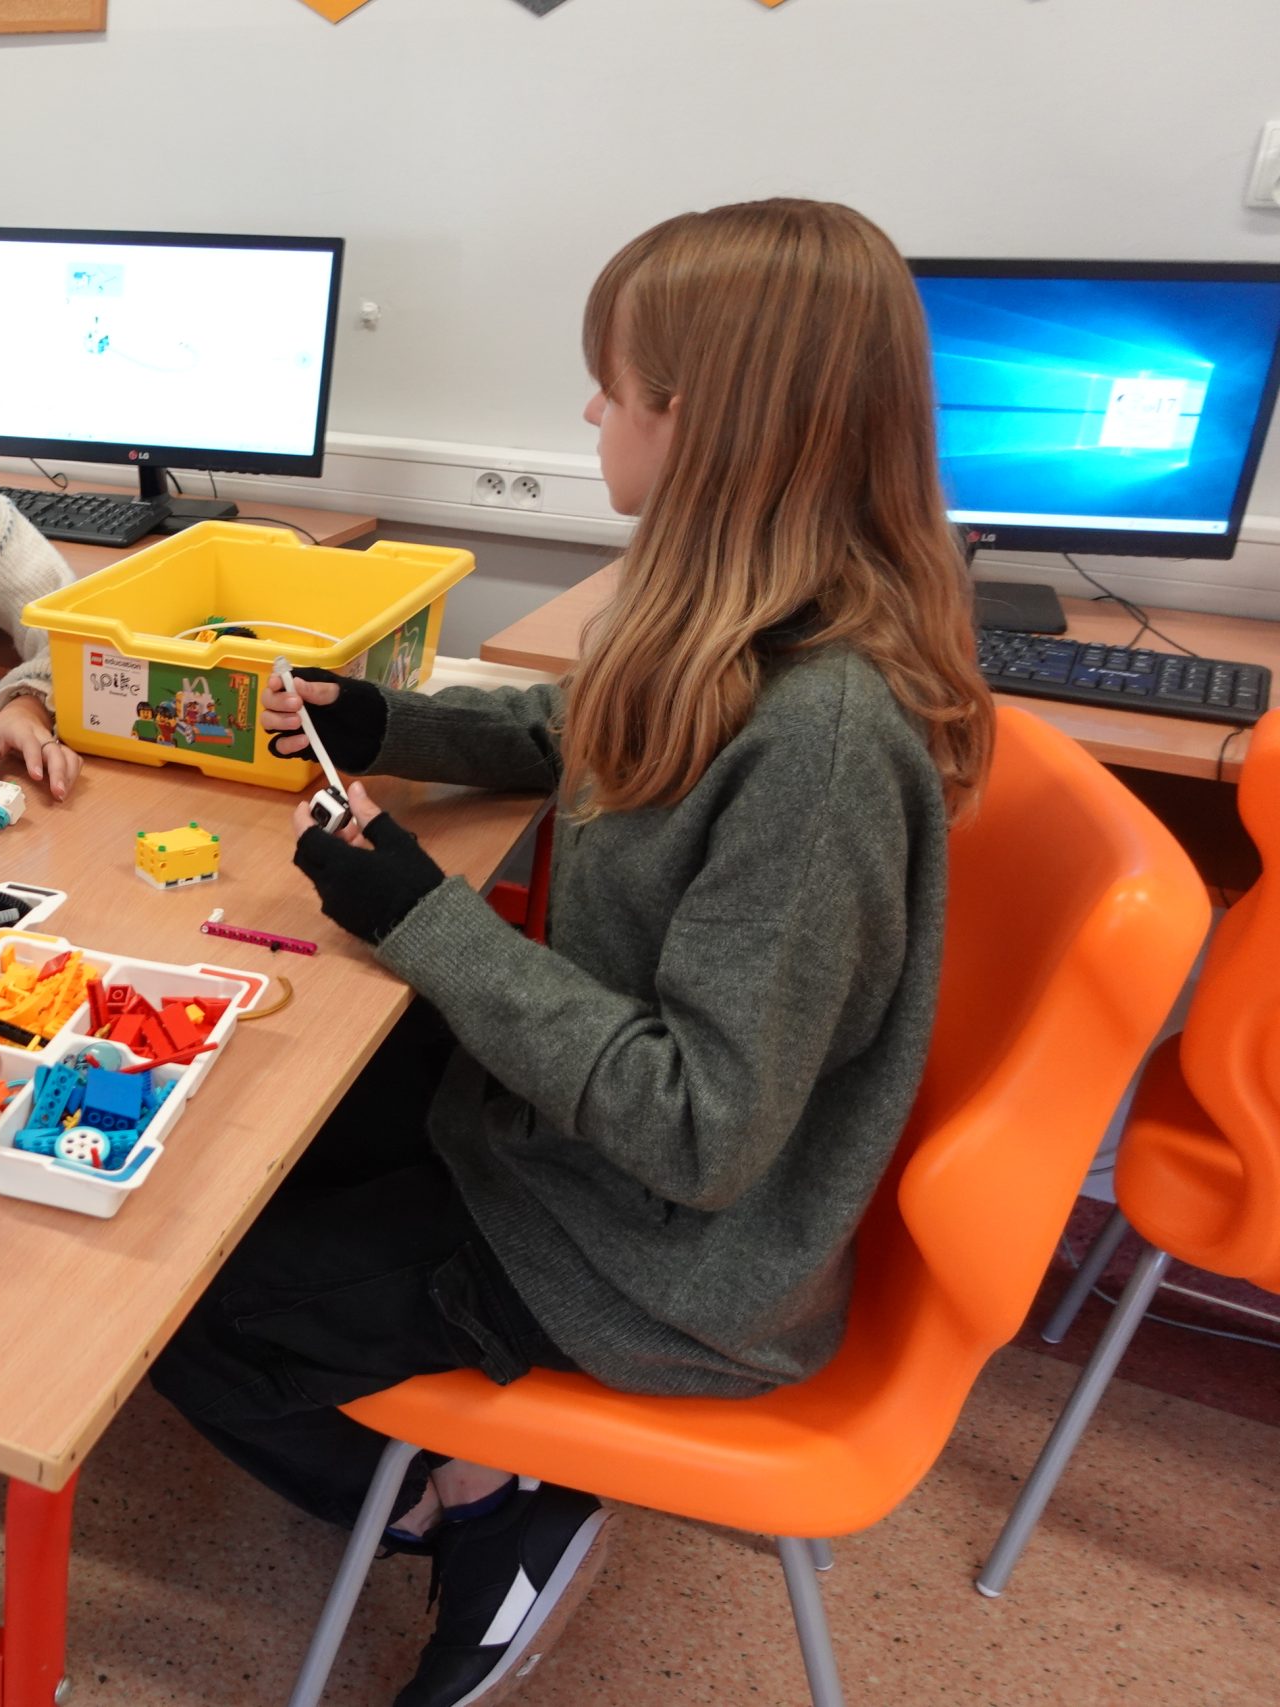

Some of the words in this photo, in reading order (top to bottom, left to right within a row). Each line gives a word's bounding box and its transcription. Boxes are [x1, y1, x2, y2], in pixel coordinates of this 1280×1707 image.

[138, 452, 150, 460] LG
[981, 533, 997, 542] LG
[104, 658, 142, 671] education
